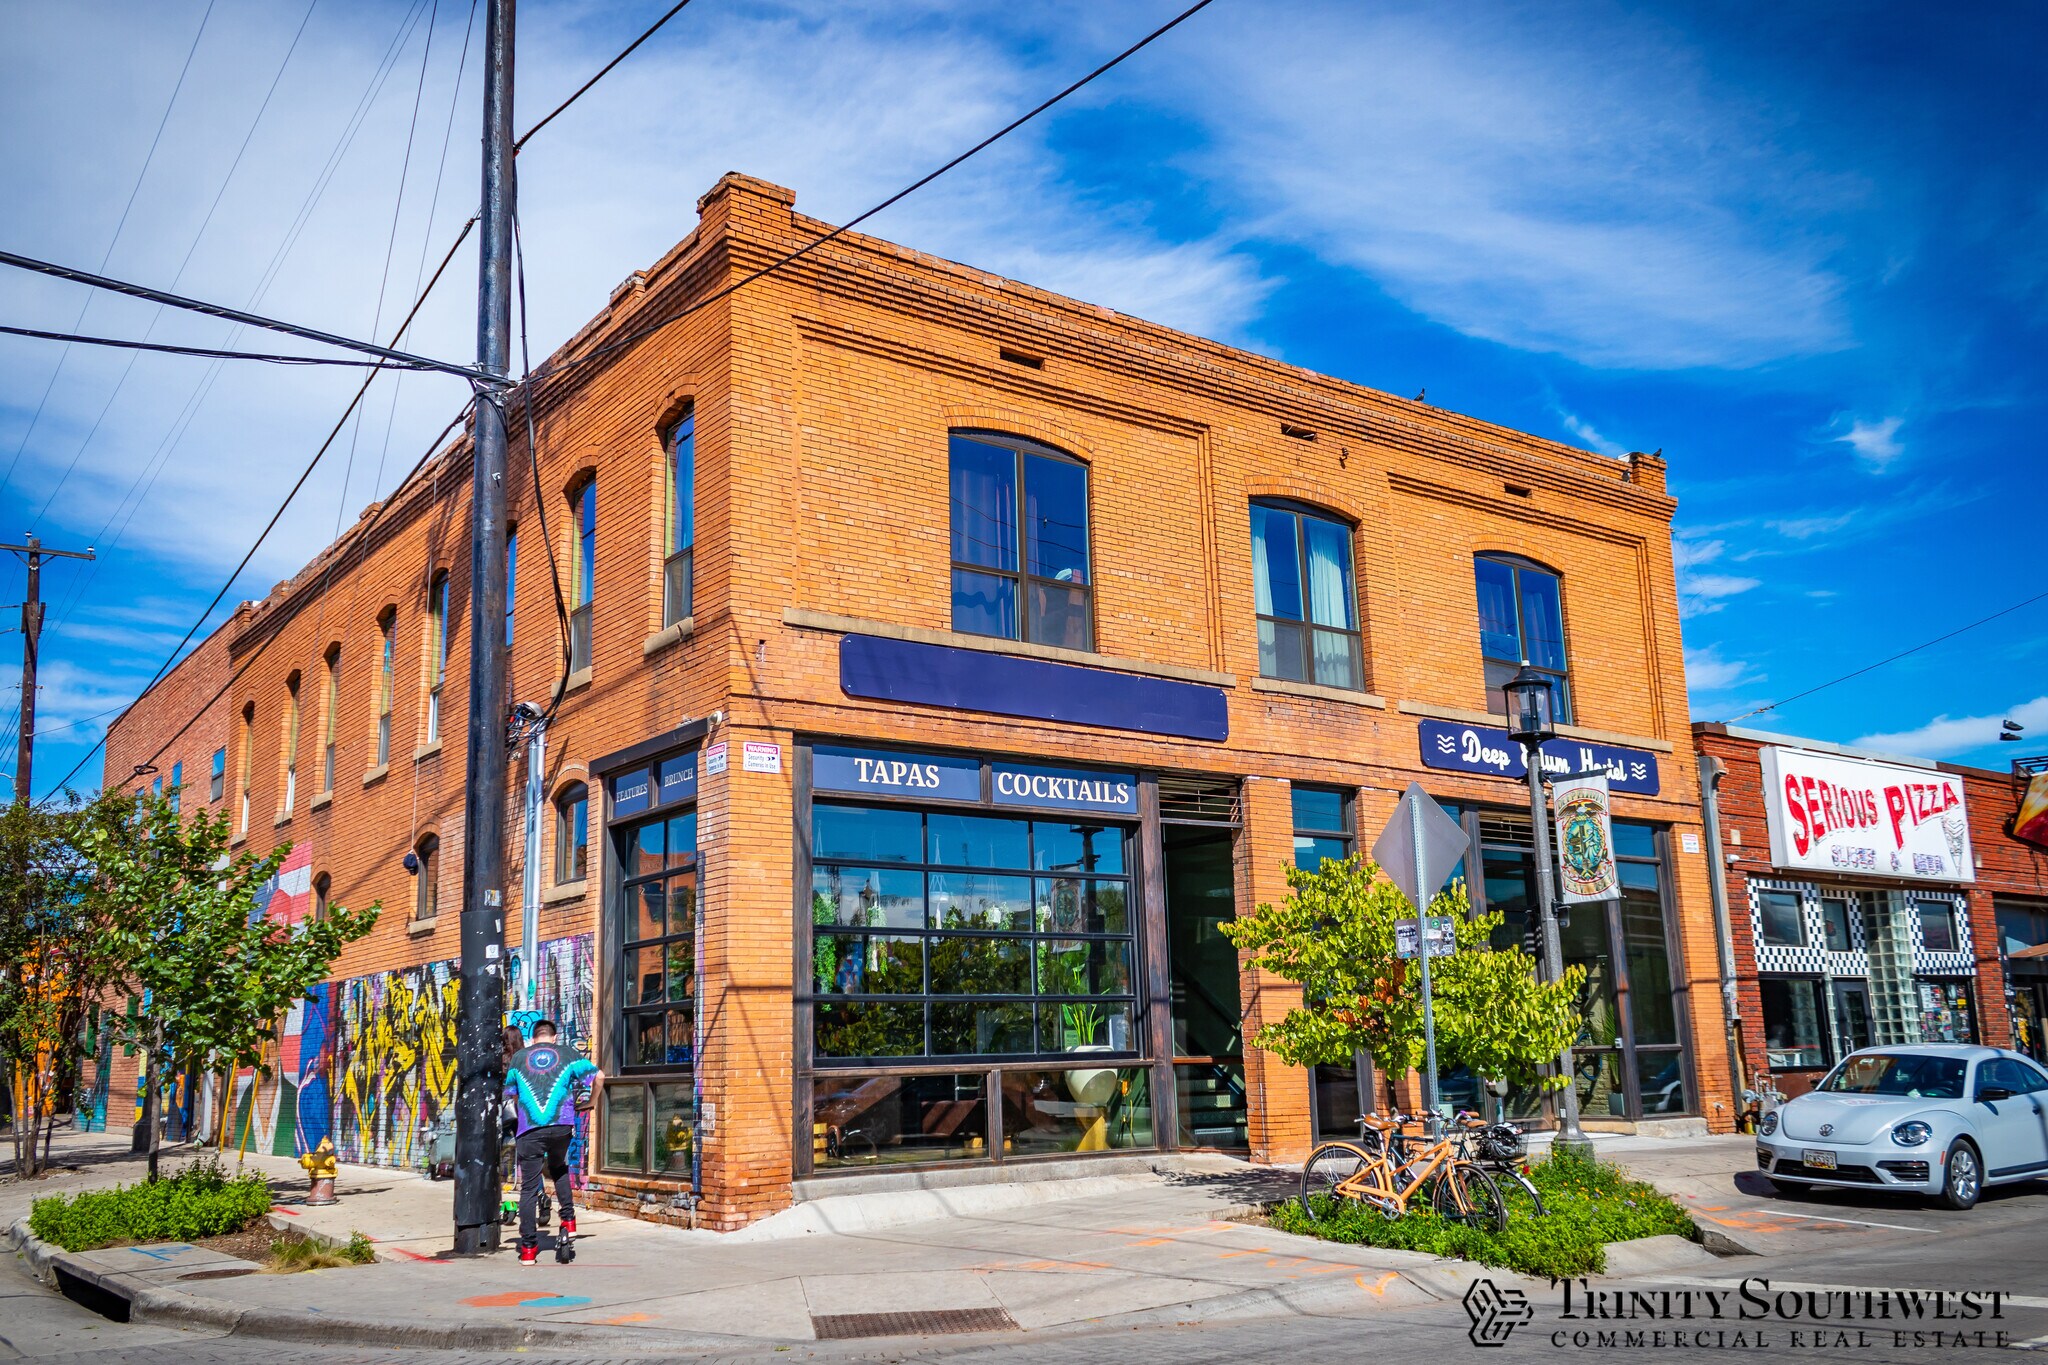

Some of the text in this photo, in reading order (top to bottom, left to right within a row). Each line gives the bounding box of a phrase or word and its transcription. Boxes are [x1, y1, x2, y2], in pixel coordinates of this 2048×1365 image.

[747, 744, 777, 754] WARNING
[748, 753, 764, 762] Security
[1461, 729, 1511, 770] Deep
[1579, 747, 1628, 782] Hotel
[664, 768, 693, 787] BRUNCH
[854, 758, 940, 788] TAPAS
[616, 783, 648, 803] FEATURES
[997, 772, 1129, 804] COCKTAILS
[1785, 773, 1960, 857] SERIOUS PIZZA
